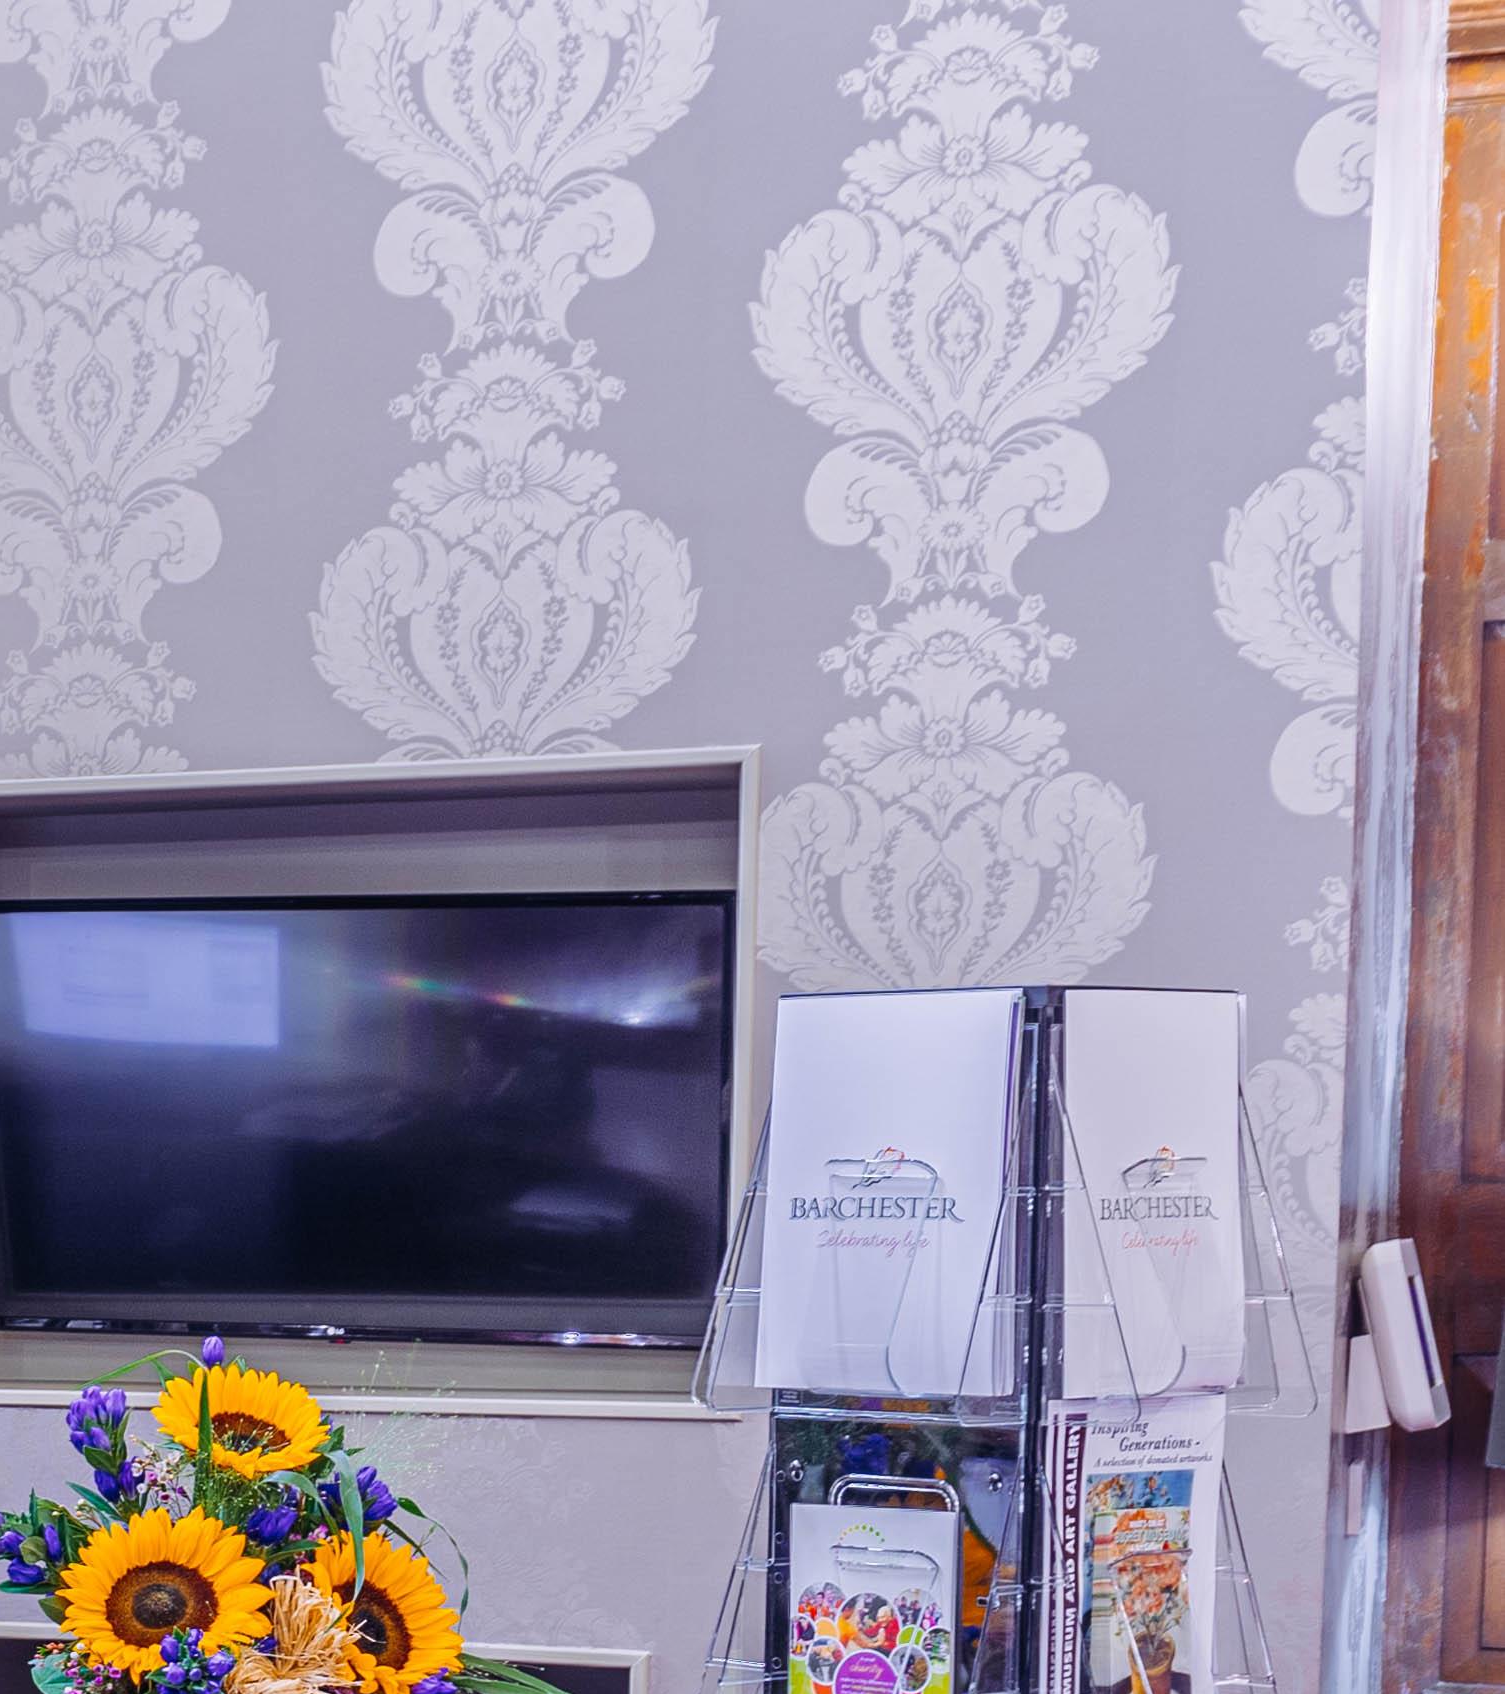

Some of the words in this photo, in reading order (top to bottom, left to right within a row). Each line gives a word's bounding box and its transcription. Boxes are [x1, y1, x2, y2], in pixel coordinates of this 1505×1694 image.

[789, 1195, 966, 1224] BARCHESTER
[1099, 1195, 1220, 1222] BARCHESTER
[1119, 1434, 1193, 1452] Generations
[1065, 1423, 1081, 1511] GALLERY
[1065, 1515, 1077, 1554] ART
[1065, 1559, 1077, 1602] AND
